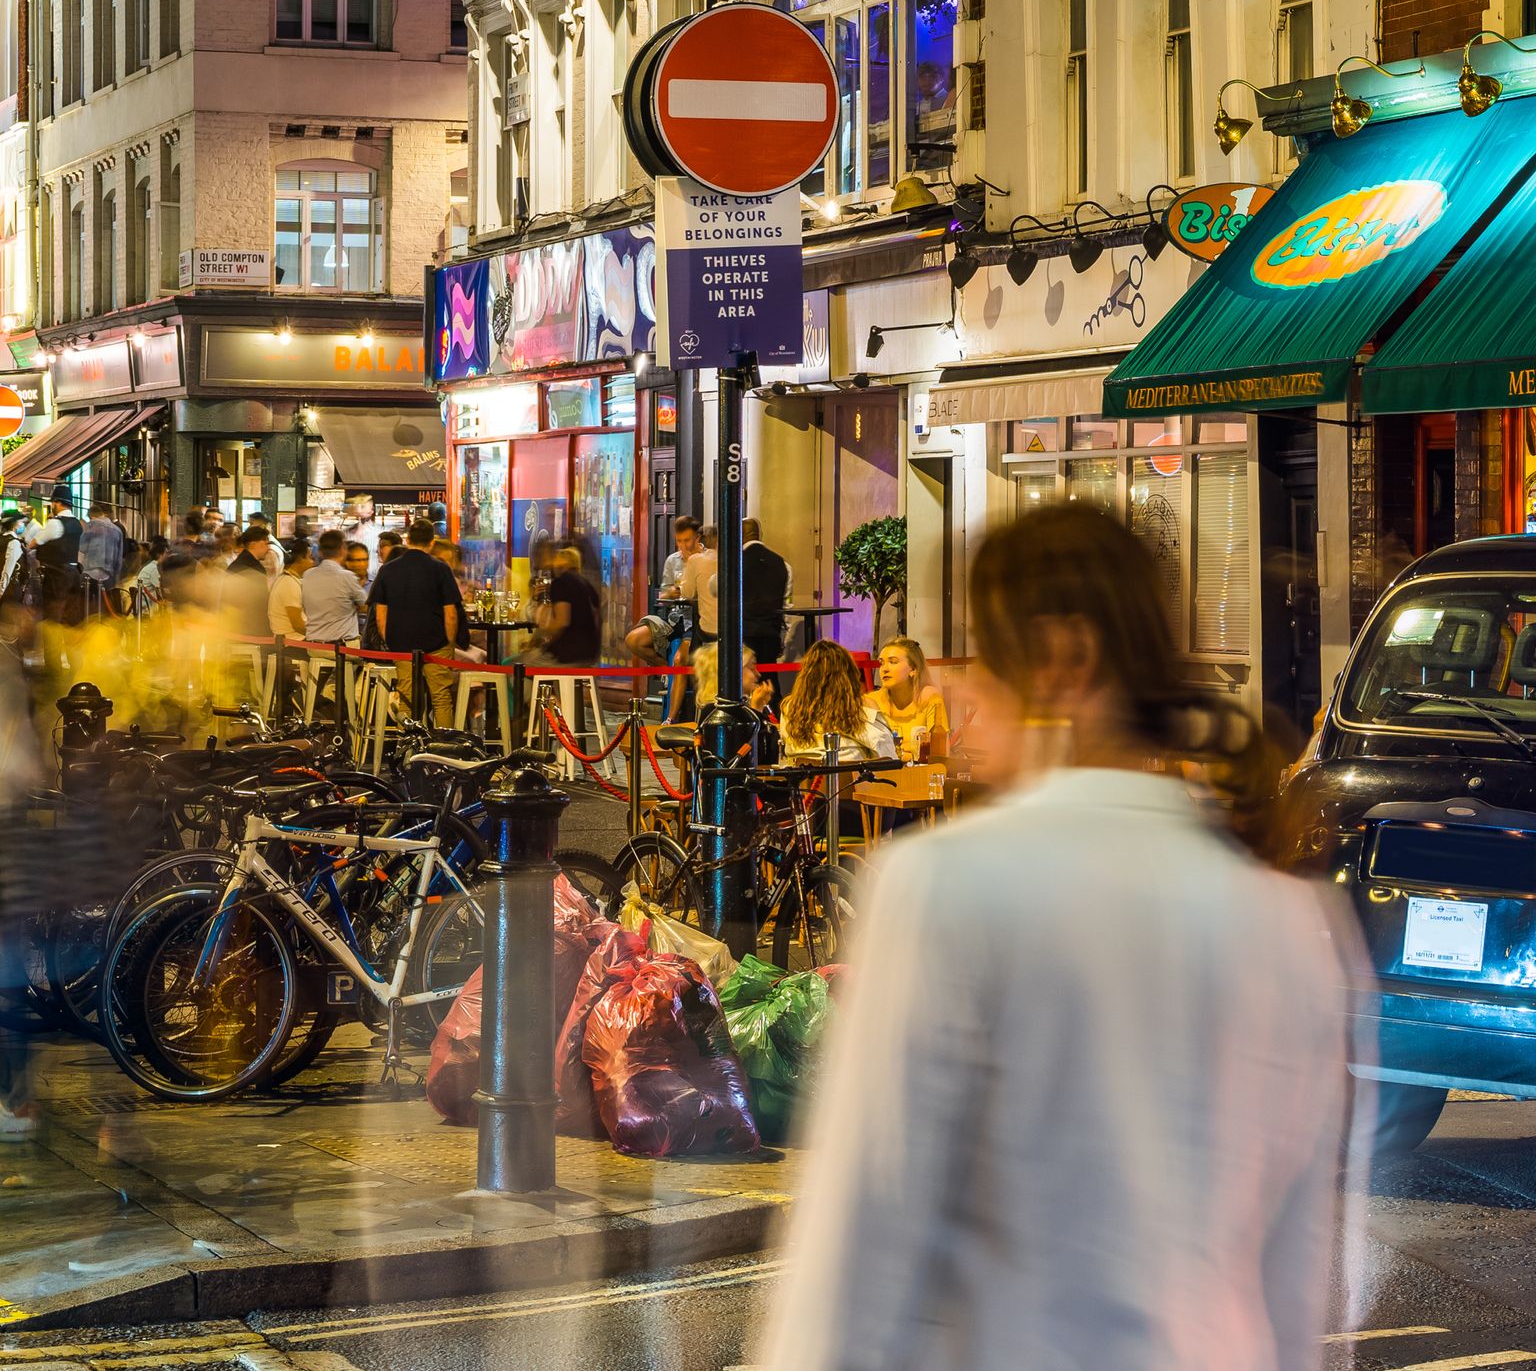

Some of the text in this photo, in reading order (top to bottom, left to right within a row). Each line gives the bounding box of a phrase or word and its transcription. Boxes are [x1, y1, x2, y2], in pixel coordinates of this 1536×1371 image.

[690, 195, 773, 207] TAKE CARE
[699, 210, 766, 223] OF YOUR
[685, 227, 783, 241] BELONGINGS
[200, 253, 264, 263] OLD COMPTON
[703, 254, 766, 268] THIEVES
[200, 264, 248, 273] STREET W1
[702, 271, 769, 285] OPERATE
[708, 288, 764, 302] IN THIS
[718, 305, 756, 318] AREA
[1126, 381, 1238, 409] MEDITERRANEAN
[929, 399, 958, 418] BLADE
[406, 450, 440, 471] BALANS
[292, 829, 337, 841] VIRTUOSO
[335, 975, 354, 1001] P
